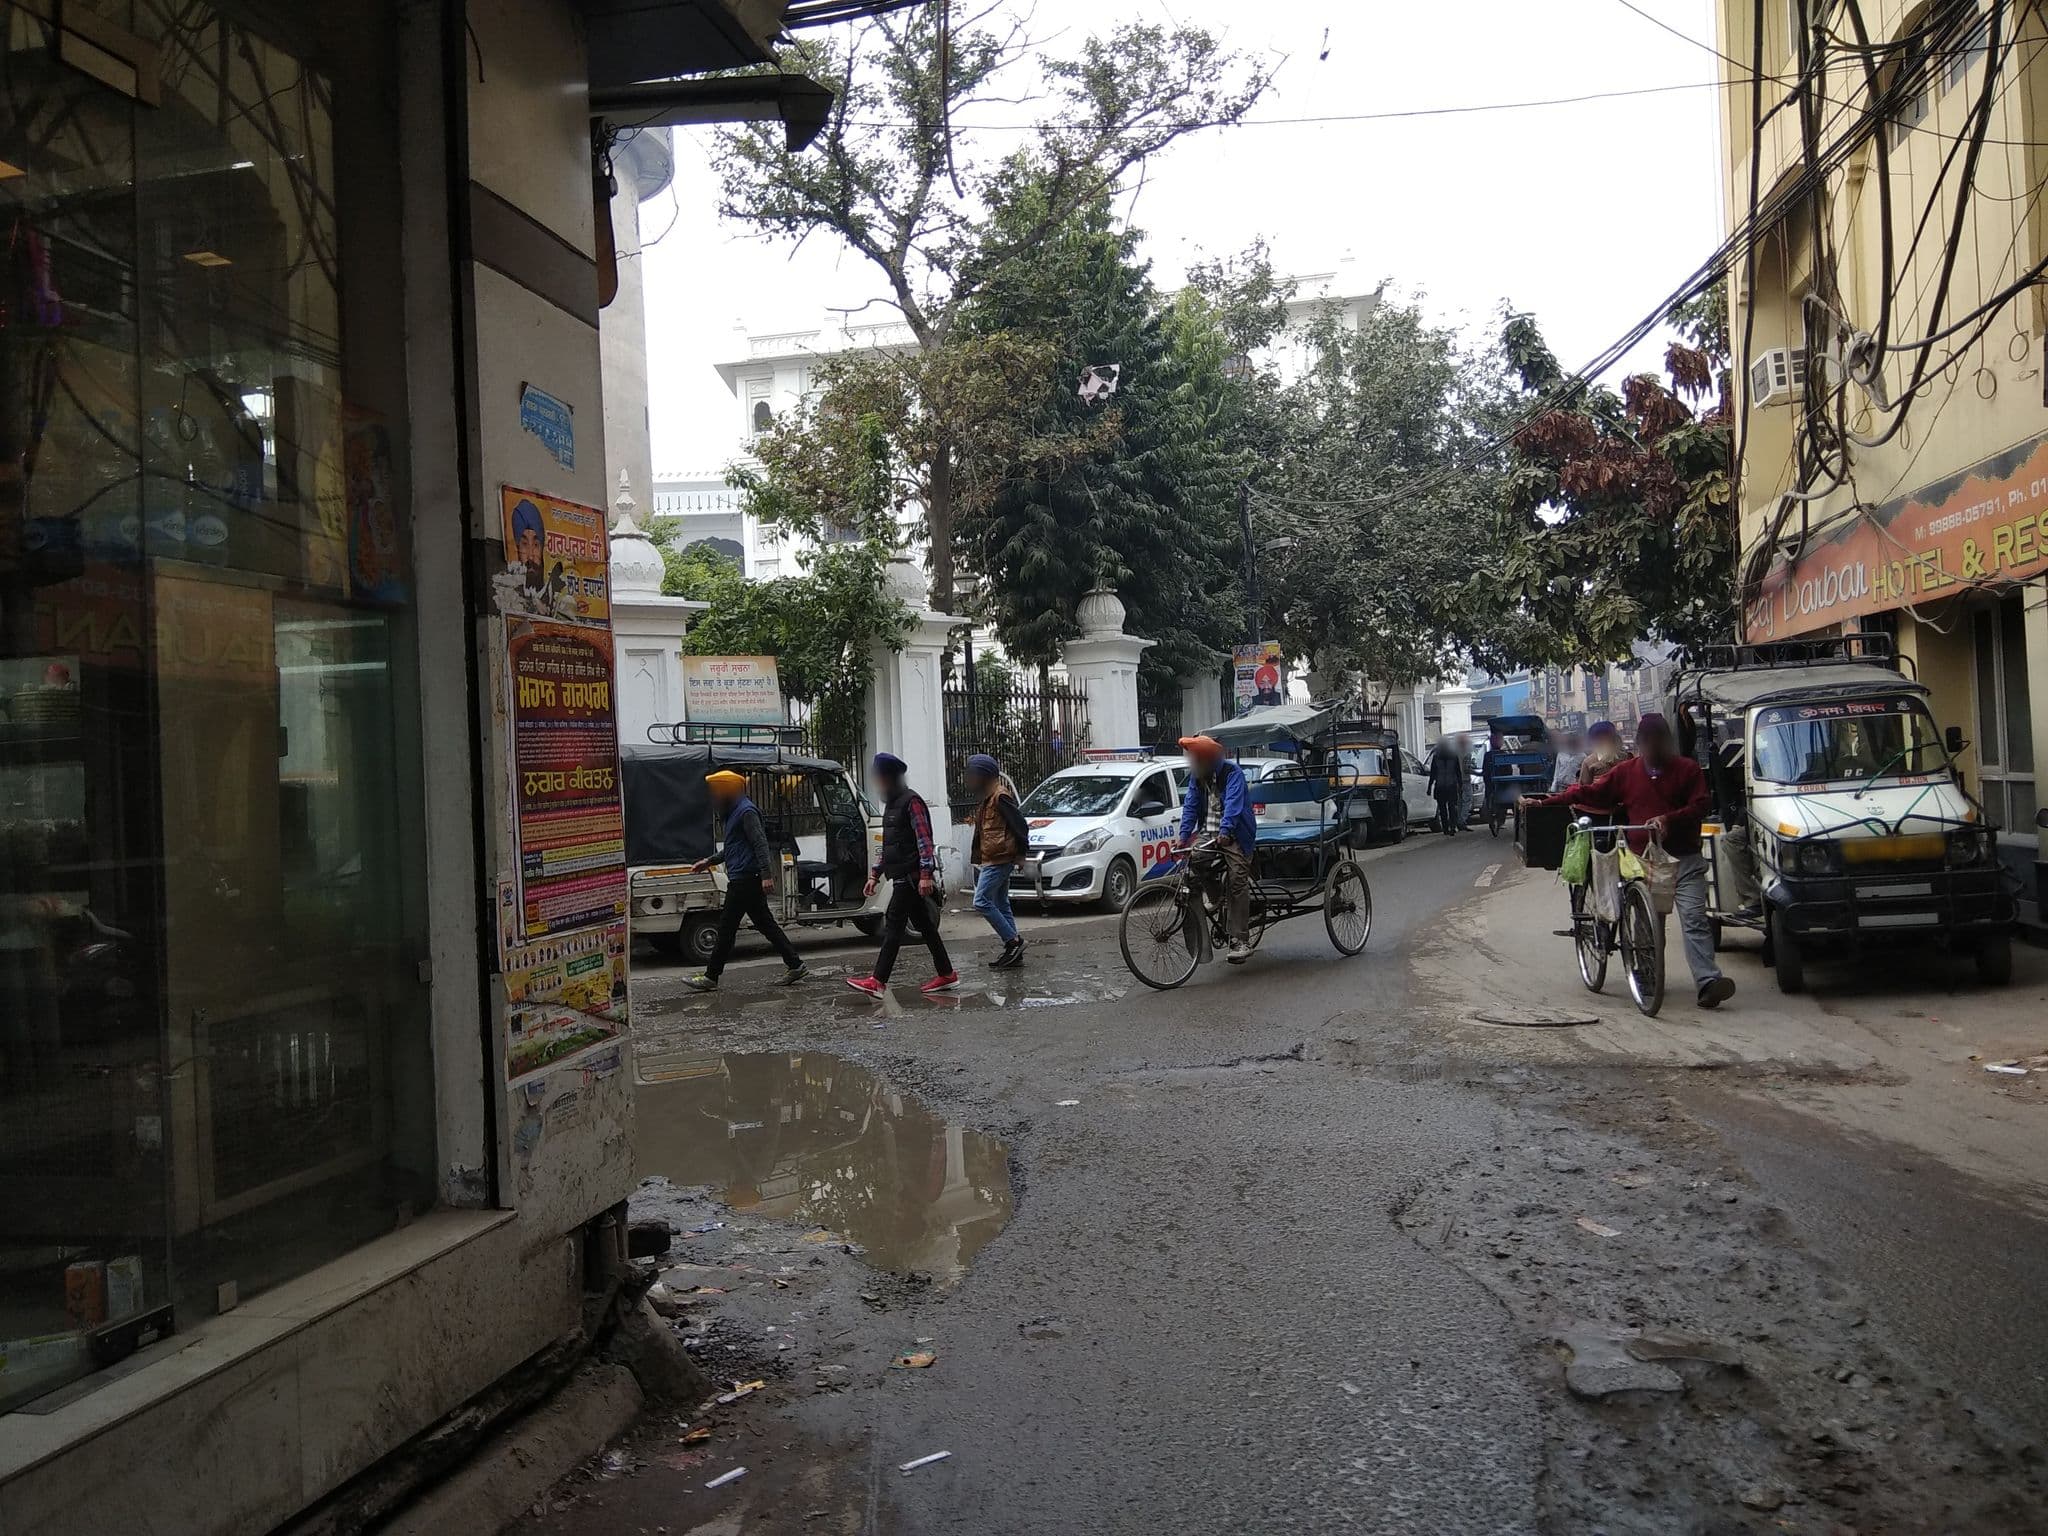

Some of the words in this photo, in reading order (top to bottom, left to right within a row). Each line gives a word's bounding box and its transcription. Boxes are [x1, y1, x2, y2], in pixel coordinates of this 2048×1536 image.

[1781, 561, 1868, 622] Darbar
[1872, 547, 1956, 604] HOTEL
[1962, 537, 1986, 579] &
[517, 675, 556, 709] ਮਹਾਨ
[1548, 668, 1558, 711] ROOMS
[1846, 703, 1886, 714] शिवाय
[524, 771, 566, 797] ਨਗਰ
[569, 765, 614, 790] ਕੀਰਤਨ
[1140, 825, 1175, 843] PUNJAB
